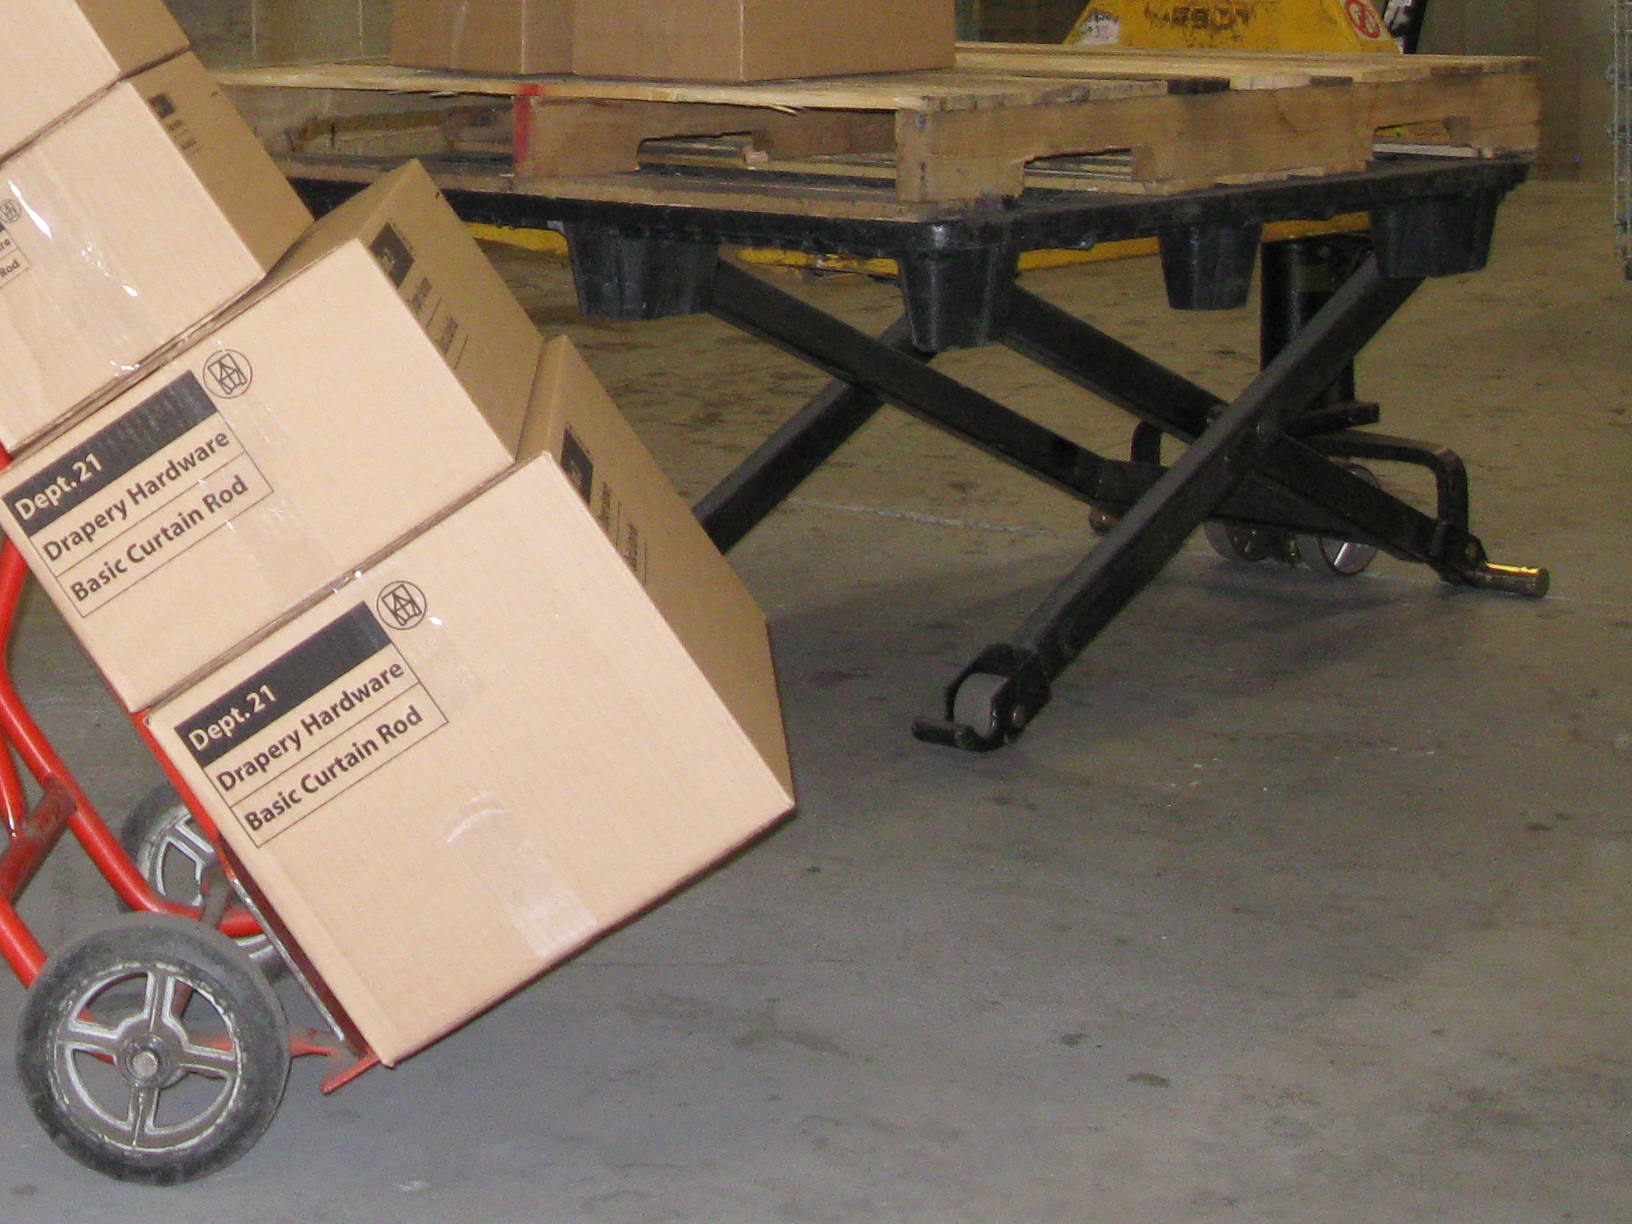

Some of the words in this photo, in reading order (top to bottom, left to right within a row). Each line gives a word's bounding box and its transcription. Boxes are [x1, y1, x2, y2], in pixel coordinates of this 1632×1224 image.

[0, 258, 21, 279] Rod
[14, 476, 78, 520] Dept.
[71, 453, 104, 483] 21
[42, 499, 129, 562] Drapery
[127, 431, 230, 506] Hardware
[69, 557, 128, 602] Basic
[126, 508, 205, 564] Curtain
[201, 473, 249, 515] Rod
[187, 707, 252, 752] Dept.
[245, 683, 277, 714] 21
[215, 728, 303, 792] Drapery
[300, 661, 405, 737] Hardware
[243, 785, 303, 833] Basic
[300, 736, 380, 794] Curtain
[375, 703, 423, 745] Rod
